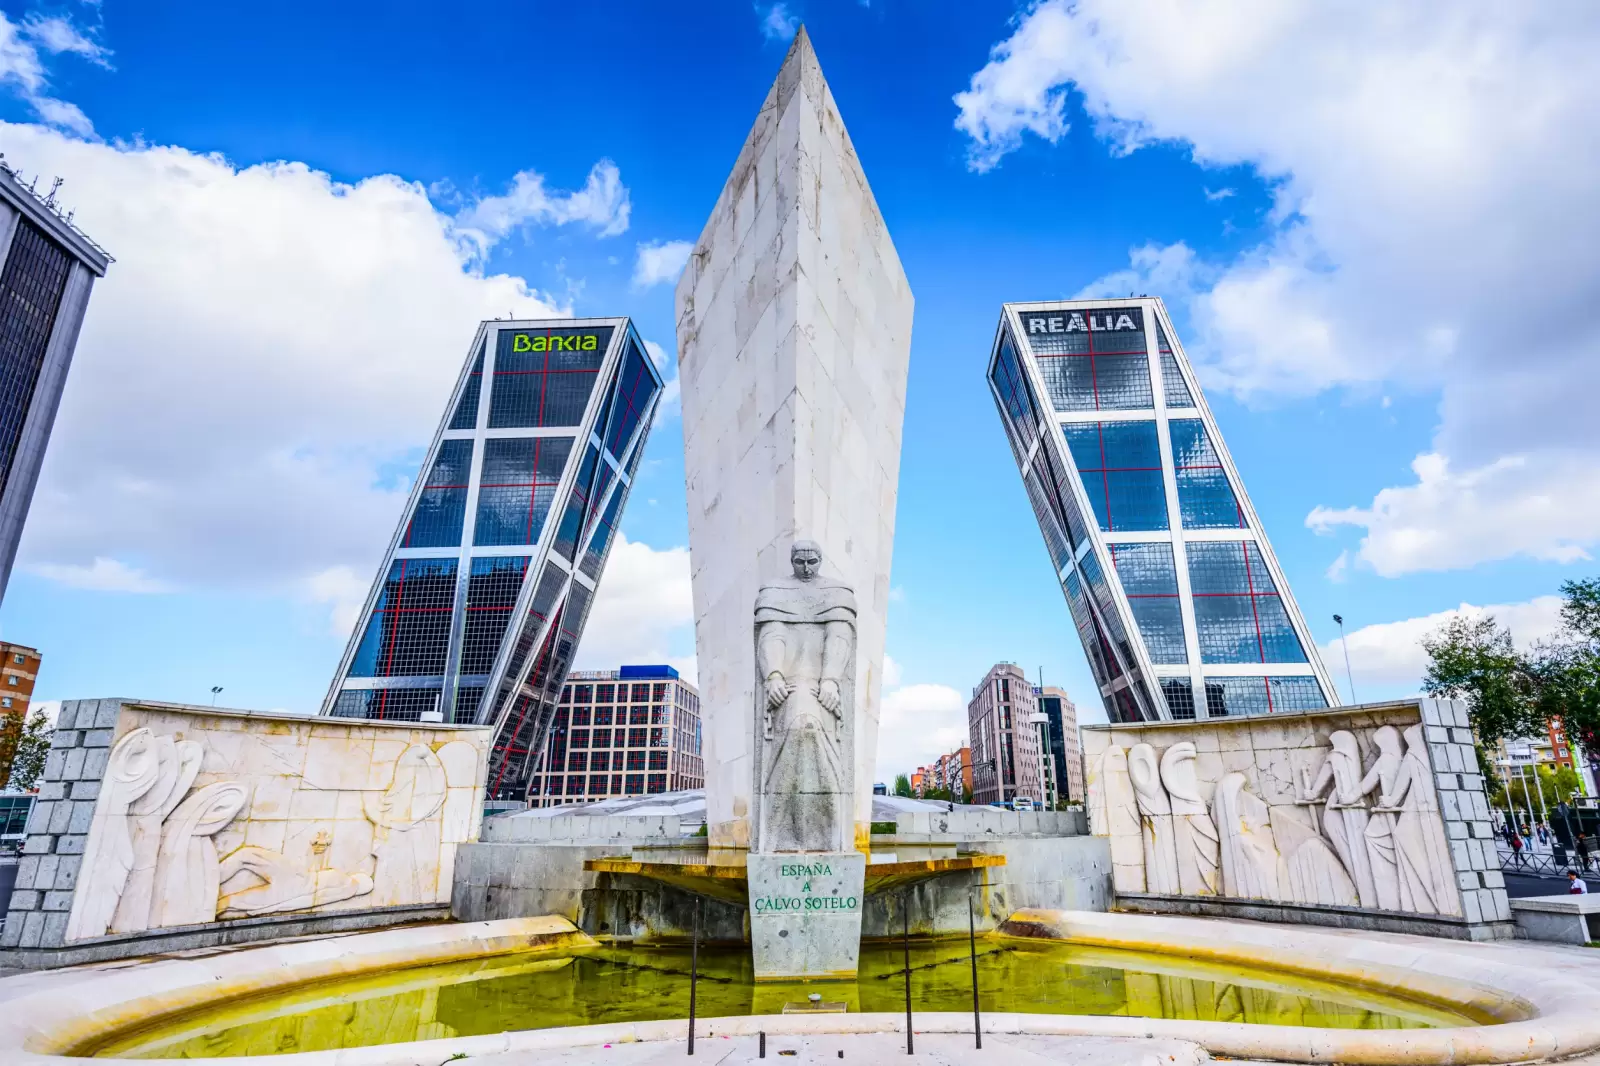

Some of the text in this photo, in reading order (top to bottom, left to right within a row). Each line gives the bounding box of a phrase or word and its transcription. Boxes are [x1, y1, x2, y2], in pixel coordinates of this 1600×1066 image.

[1029, 313, 1137, 333] REALIA
[513, 334, 597, 352] Bankia
[781, 863, 832, 876] ESPAÑA
[802, 882, 812, 892] A
[755, 896, 857, 910] CALVO SOTELO
